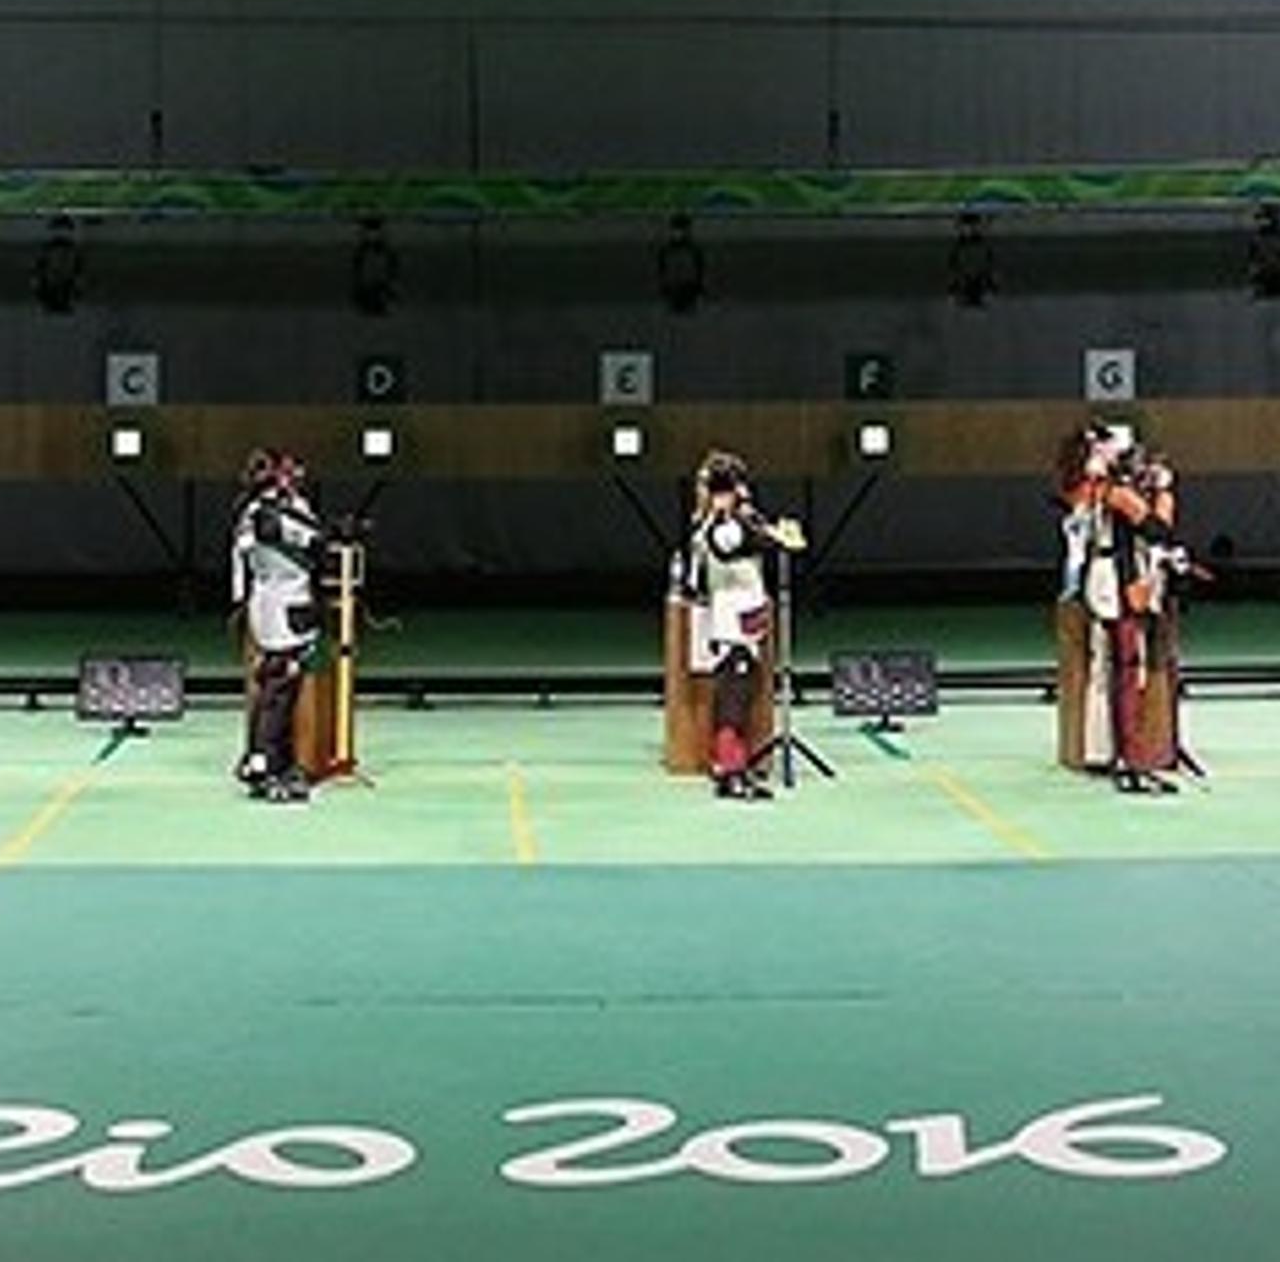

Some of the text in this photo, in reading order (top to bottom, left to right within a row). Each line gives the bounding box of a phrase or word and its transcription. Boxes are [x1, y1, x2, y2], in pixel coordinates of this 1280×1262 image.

[122, 364, 147, 396] C
[366, 363, 396, 396] D
[1096, 359, 1125, 391] G
[500, 1096, 1228, 1184] 2016
